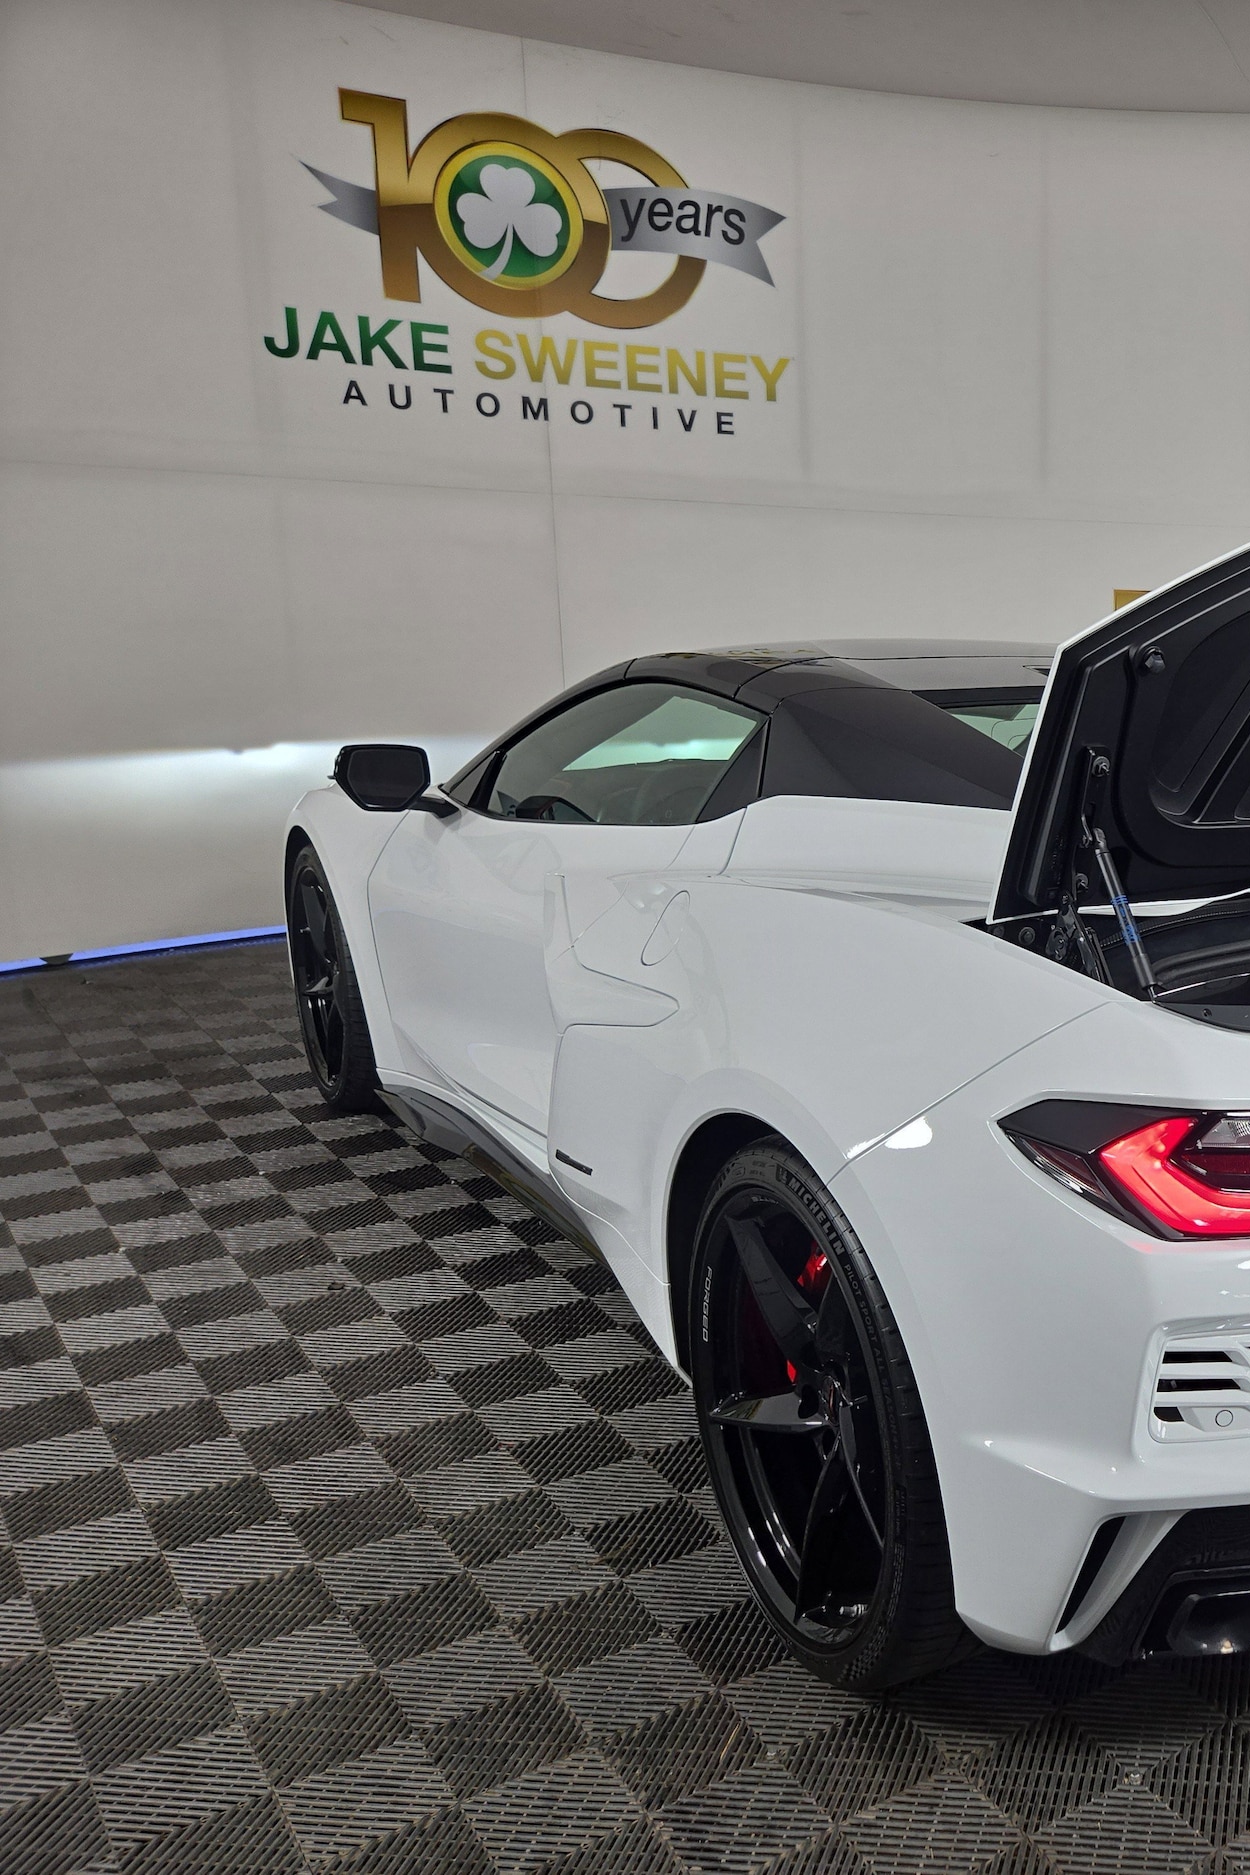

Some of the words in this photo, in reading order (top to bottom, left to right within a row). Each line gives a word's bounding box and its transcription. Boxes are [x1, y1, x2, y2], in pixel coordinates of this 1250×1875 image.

[338, 88, 707, 329] 100
[620, 196, 747, 246] years
[264, 306, 453, 374] JAKE
[474, 328, 792, 402] SWEENEY
[342, 379, 736, 435] AUTOMOTIVE
[702, 1265, 713, 1342] FORGED
[788, 1176, 846, 1257] MICHELIN
[843, 1263, 862, 1297] PILOT
[859, 1301, 878, 1342] SPORT
[873, 1346, 886, 1373] ALL
